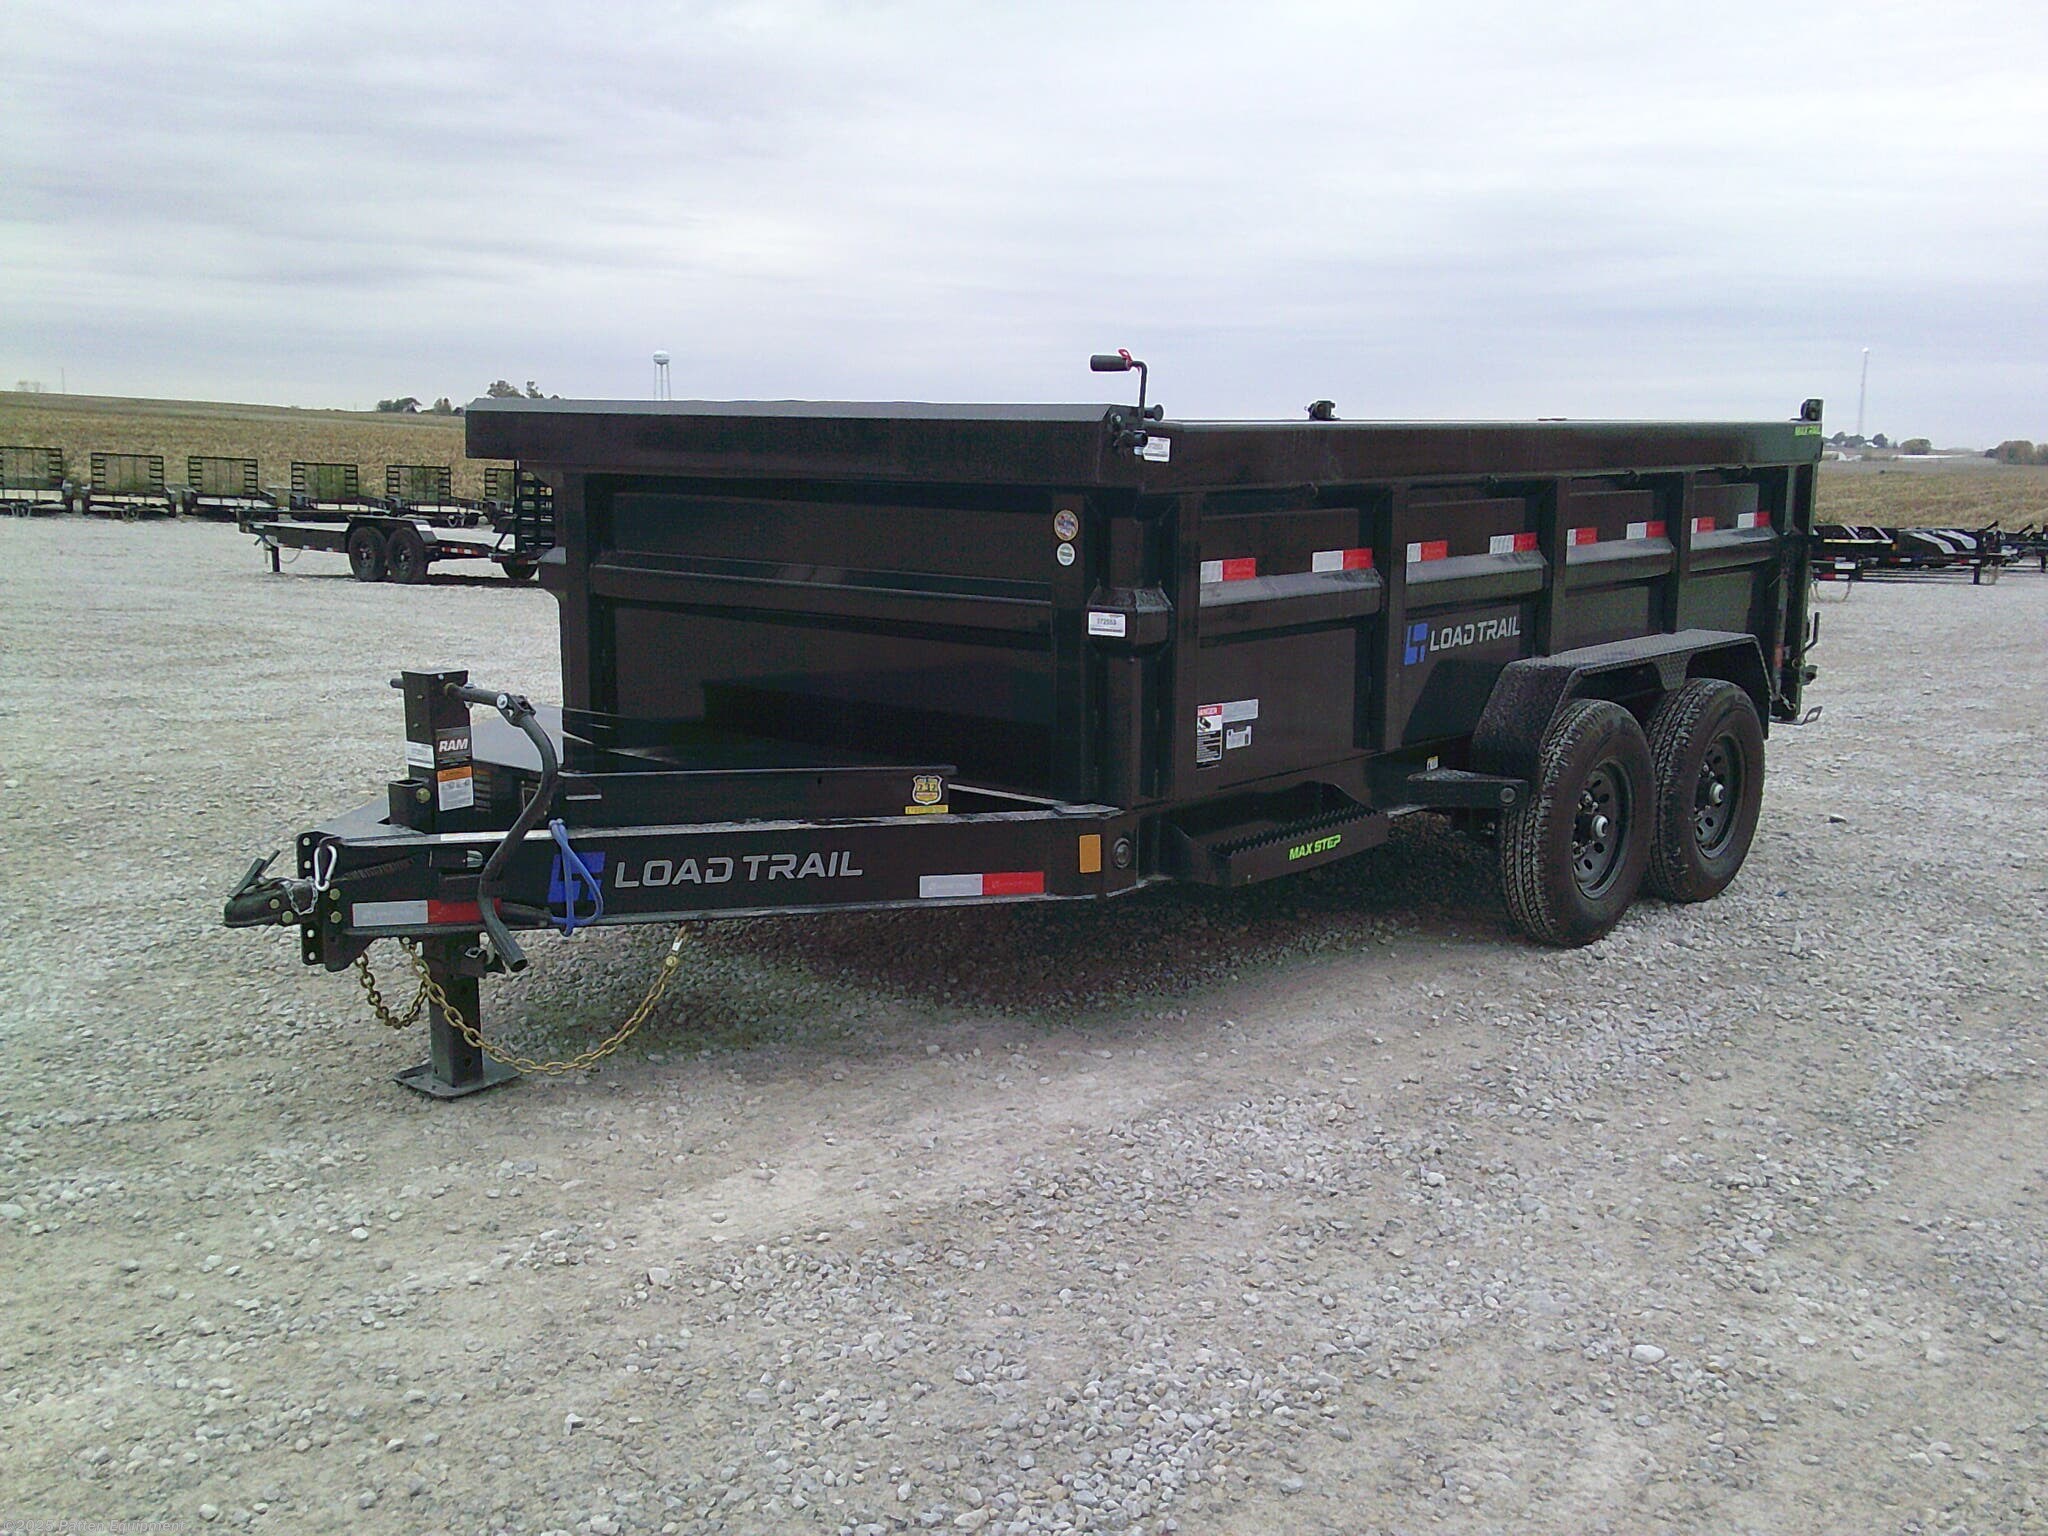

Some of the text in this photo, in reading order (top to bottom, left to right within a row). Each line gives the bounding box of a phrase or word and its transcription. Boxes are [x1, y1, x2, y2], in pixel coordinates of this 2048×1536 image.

[1429, 616, 1521, 652] LOAD TRAIL
[439, 738, 469, 752] RAM
[1289, 834, 1342, 860] MAX STEP
[614, 851, 863, 888] LOAD TRAIL
